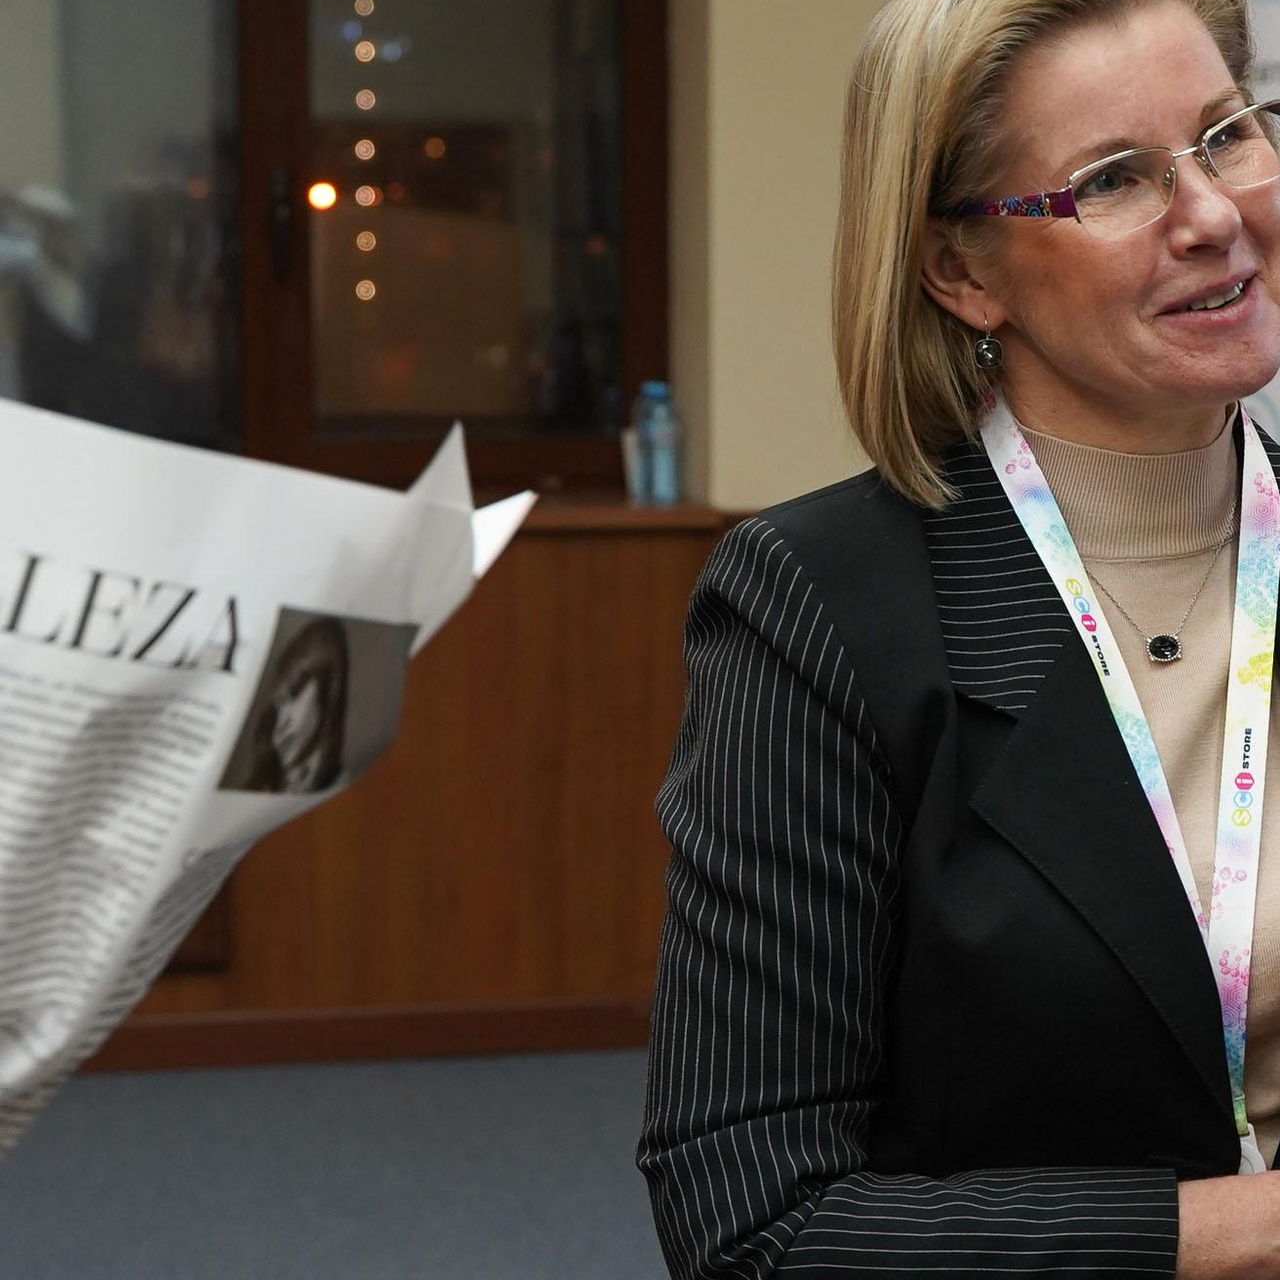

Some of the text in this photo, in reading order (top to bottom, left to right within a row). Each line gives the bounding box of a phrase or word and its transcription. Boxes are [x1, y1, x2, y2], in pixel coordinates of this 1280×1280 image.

[0, 554, 240, 674] LEZA
[1091, 634, 1111, 677] STORE
[1242, 728, 1252, 769] STORE
